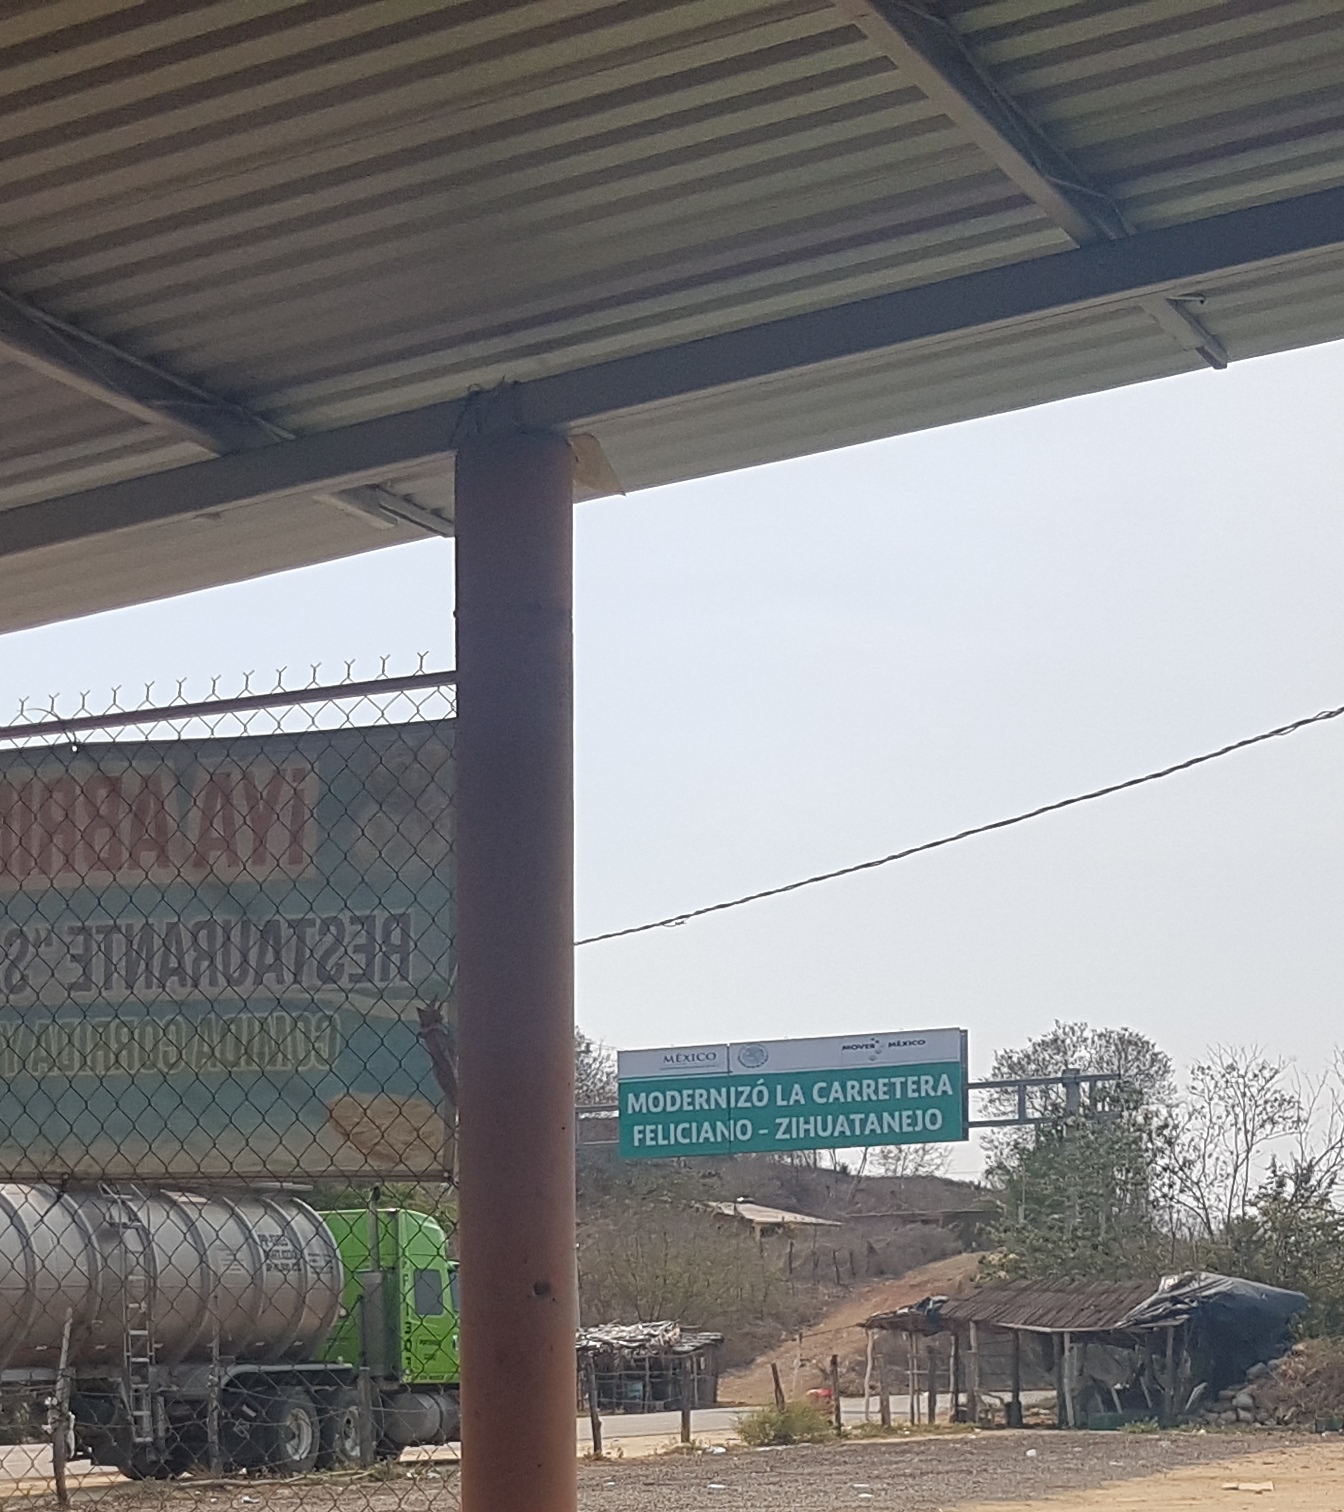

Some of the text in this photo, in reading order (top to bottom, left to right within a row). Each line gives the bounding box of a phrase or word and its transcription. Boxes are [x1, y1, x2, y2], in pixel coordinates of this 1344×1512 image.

[662, 1050, 717, 1065] MÉXICO
[842, 1037, 926, 1052] MOVER MÉXICO
[627, 1073, 953, 1115] MODERNIZÓ LA CARRETERA
[633, 1118, 753, 1147] FELICIANO
[775, 1108, 943, 1141] ZIHUATANEJO
